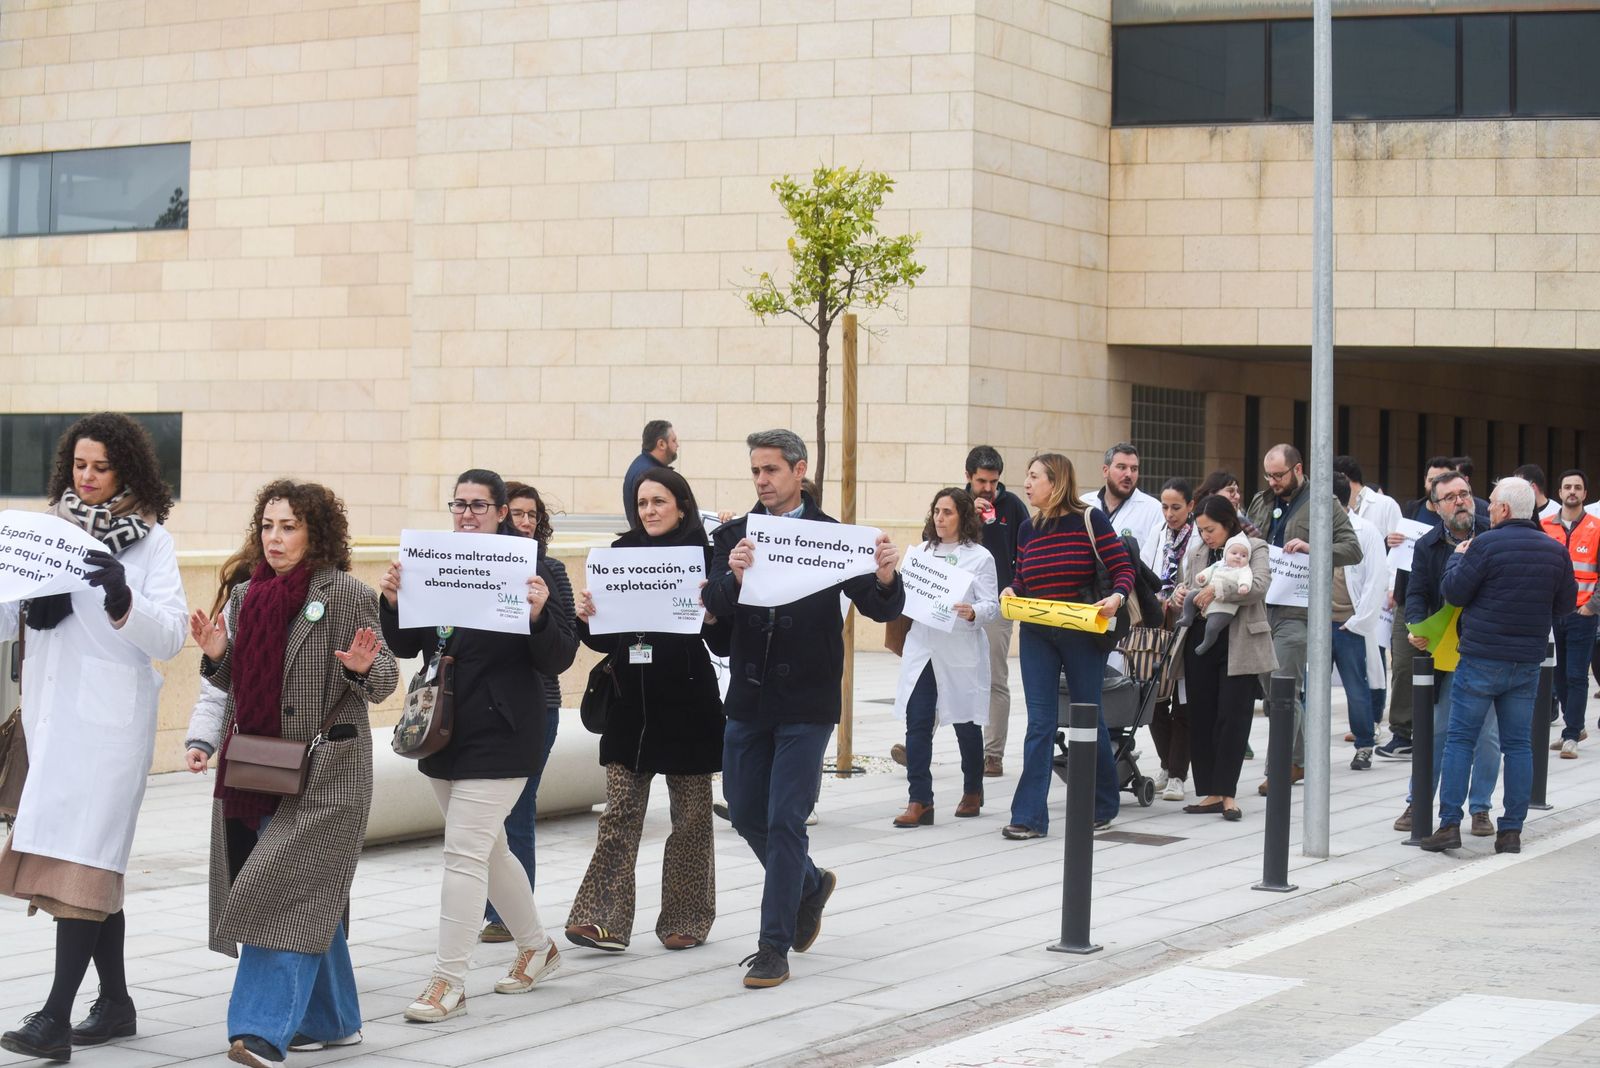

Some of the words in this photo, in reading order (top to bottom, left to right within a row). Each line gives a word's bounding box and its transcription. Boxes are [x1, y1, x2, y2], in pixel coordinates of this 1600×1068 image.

[0, 525, 42, 543] España
[44, 538, 54, 547] a
[750, 531, 771, 544] “Es
[774, 536, 791, 547] un
[795, 535, 854, 555] fonendo,
[858, 545, 875, 556] no
[14, 548, 45, 562] aquí
[45, 556, 62, 570] no
[403, 547, 452, 561] “Médicos
[455, 550, 528, 565] maltratados,
[768, 553, 794, 565] una
[797, 554, 854, 571] cadena”
[438, 565, 491, 578] pacientes
[587, 563, 609, 576] “No
[612, 567, 625, 575] es
[628, 562, 686, 575] vocación,
[688, 564, 702, 574] es
[424, 577, 508, 591] abandonados”
[605, 578, 683, 593] explotación”
[930, 581, 950, 595] para
